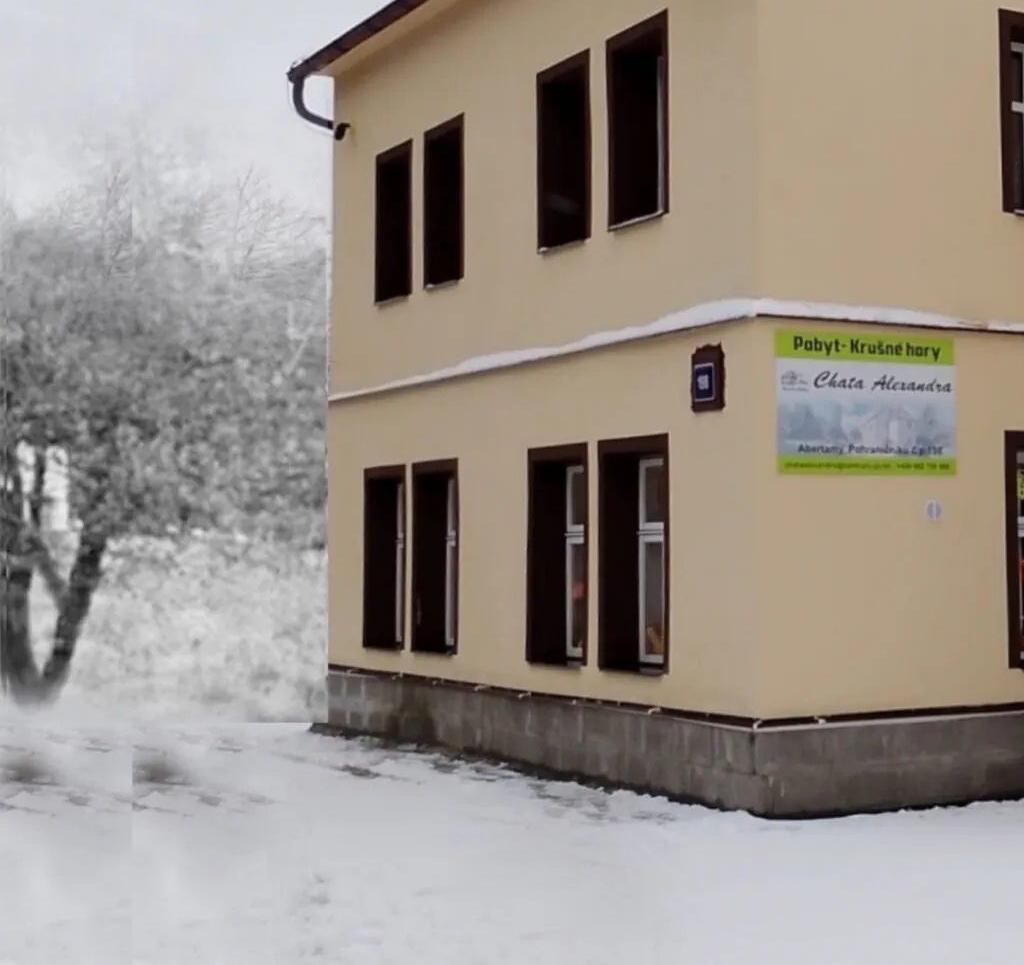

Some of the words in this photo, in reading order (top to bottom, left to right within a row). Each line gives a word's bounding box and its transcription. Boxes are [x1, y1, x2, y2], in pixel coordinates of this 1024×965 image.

[850, 338, 903, 355] Krušné
[905, 341, 942, 362] hory
[813, 370, 865, 390] Chata
[871, 374, 953, 394] Alexandra
